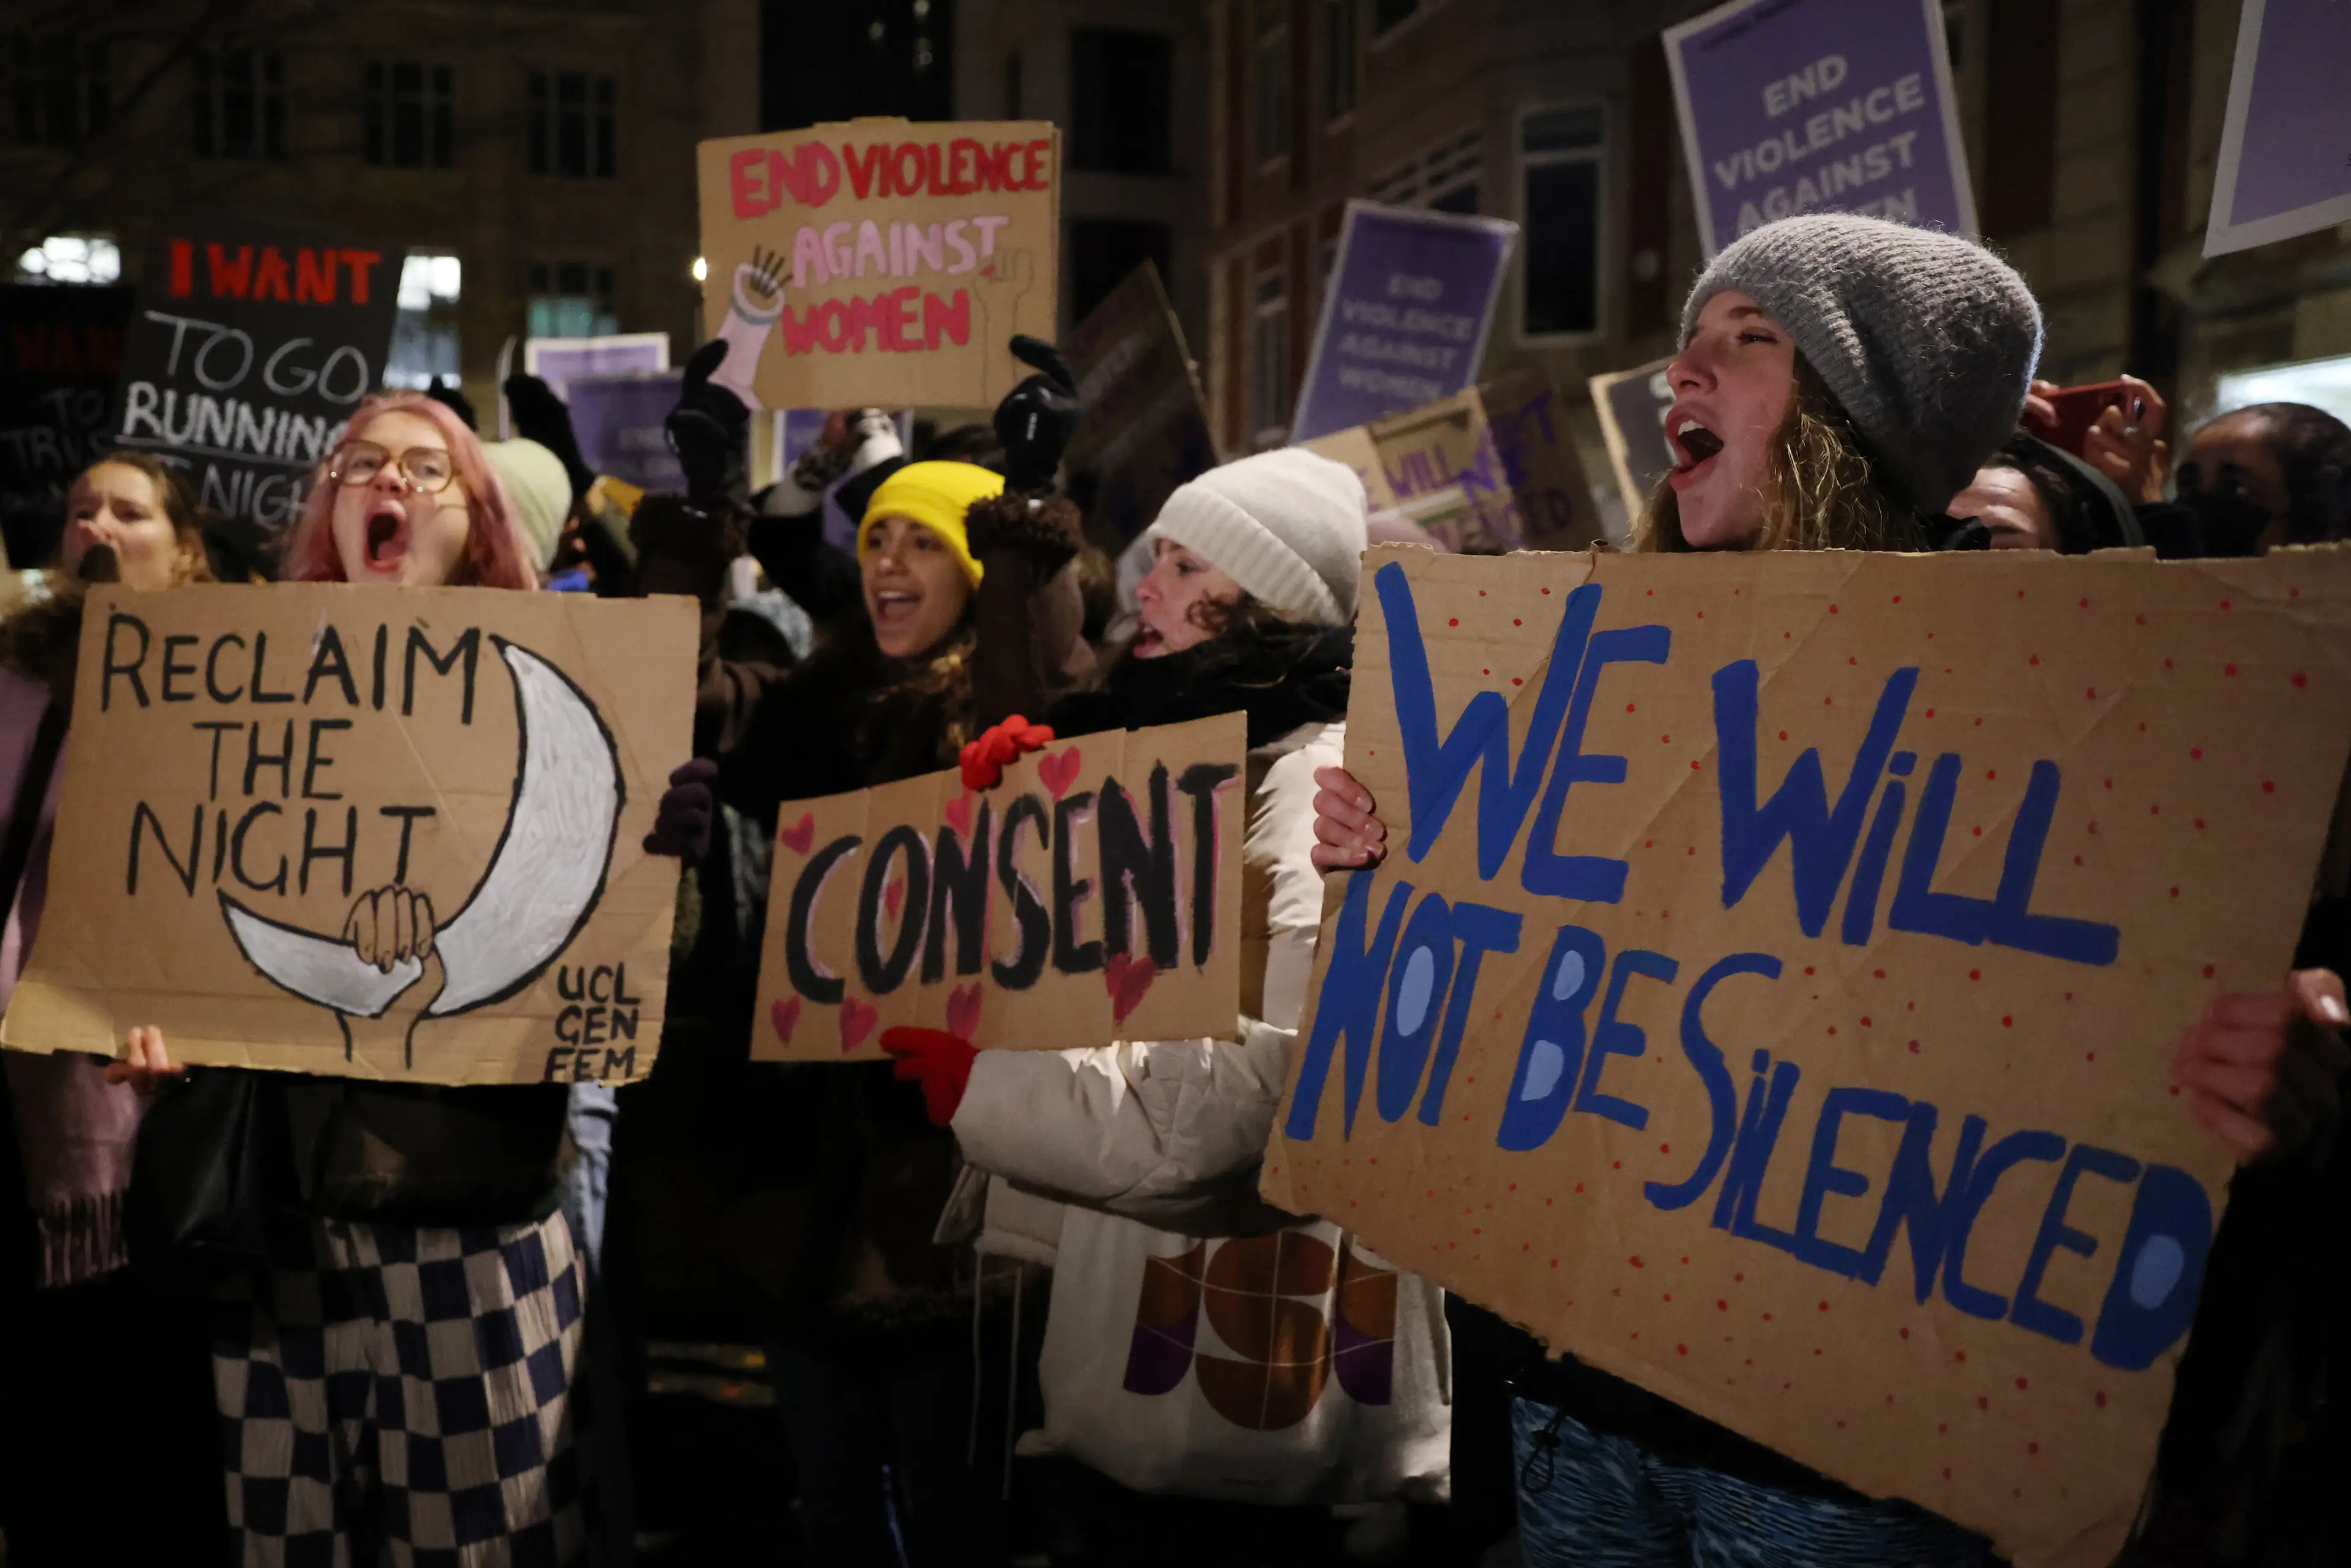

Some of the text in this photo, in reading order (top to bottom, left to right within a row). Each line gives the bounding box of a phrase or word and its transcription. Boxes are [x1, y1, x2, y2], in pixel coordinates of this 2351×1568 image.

[1761, 54, 1848, 118] END
[1715, 72, 1924, 189] VIOLENCE
[731, 138, 1051, 219] END VIOLENCE
[1738, 130, 1917, 234] AGAINST
[170, 238, 381, 305] I WANT
[792, 216, 1009, 288] AGAINST
[782, 287, 970, 356] WOMEN
[144, 310, 369, 441] TO GO
[101, 612, 480, 724] RECLAIM
[193, 719, 352, 800] THE
[1374, 561, 1671, 904] WE
[127, 801, 435, 897] NIGHT
[786, 759, 1239, 1003] CONSENT
[558, 962, 640, 1004] UCL
[1285, 869, 1523, 1142] NOT
[1497, 925, 1678, 1152] BE
[544, 1046, 636, 1082] FEM
